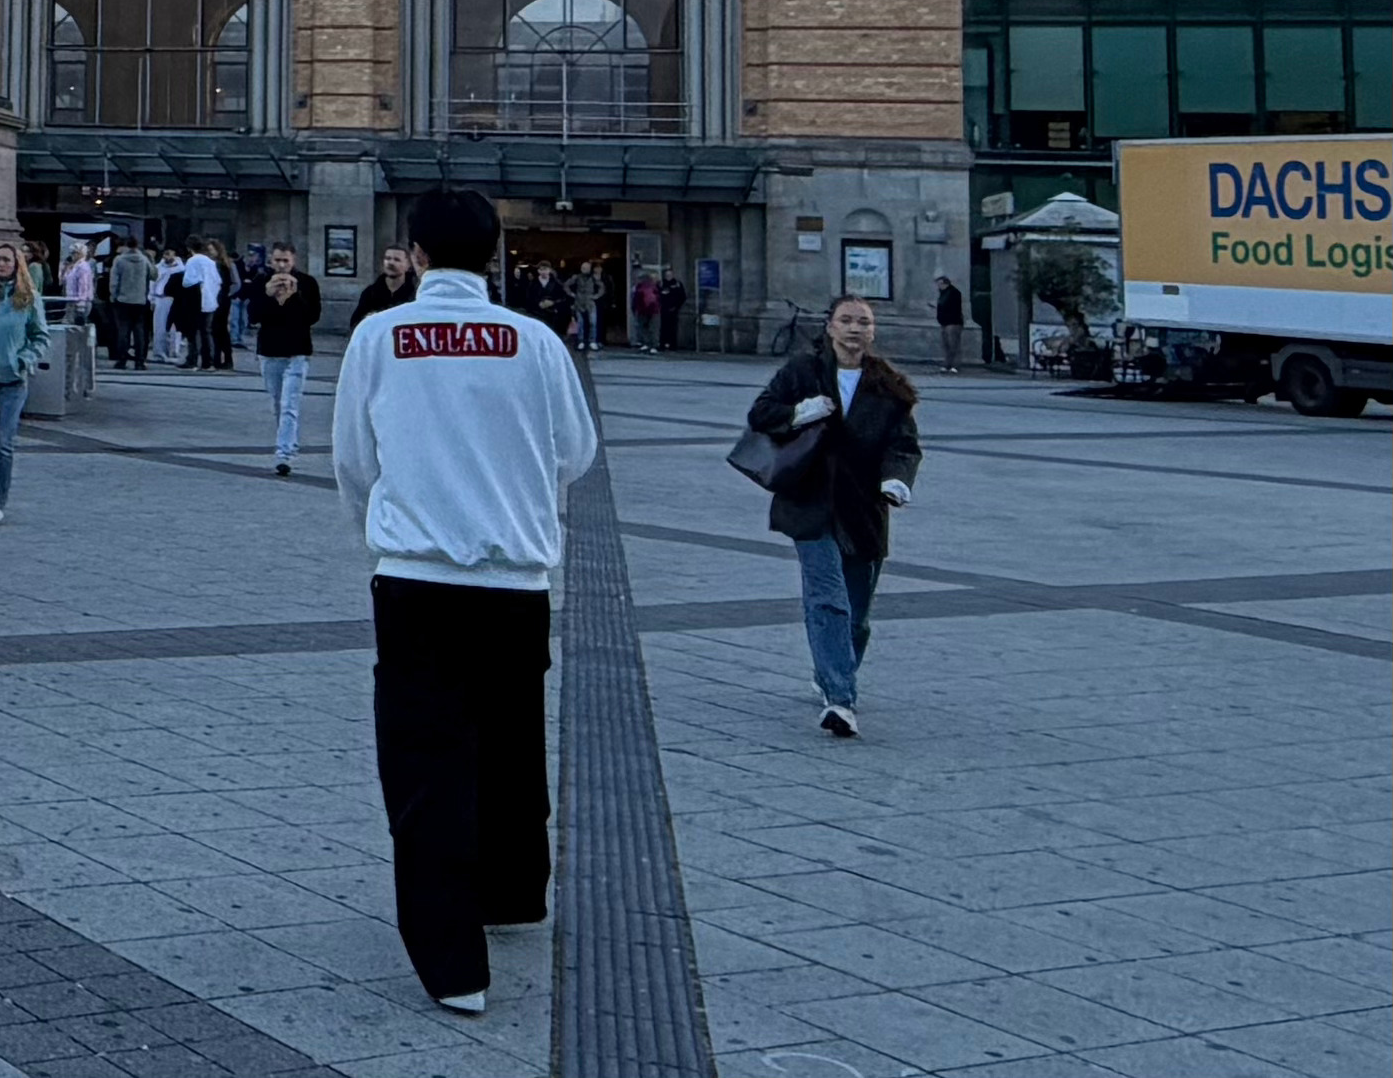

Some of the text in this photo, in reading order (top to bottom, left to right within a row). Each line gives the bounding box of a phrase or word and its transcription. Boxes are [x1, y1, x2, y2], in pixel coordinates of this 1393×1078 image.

[1208, 159, 1392, 222] DACHS
[1211, 231, 1293, 266] Food
[398, 327, 513, 354] ENGLAND
